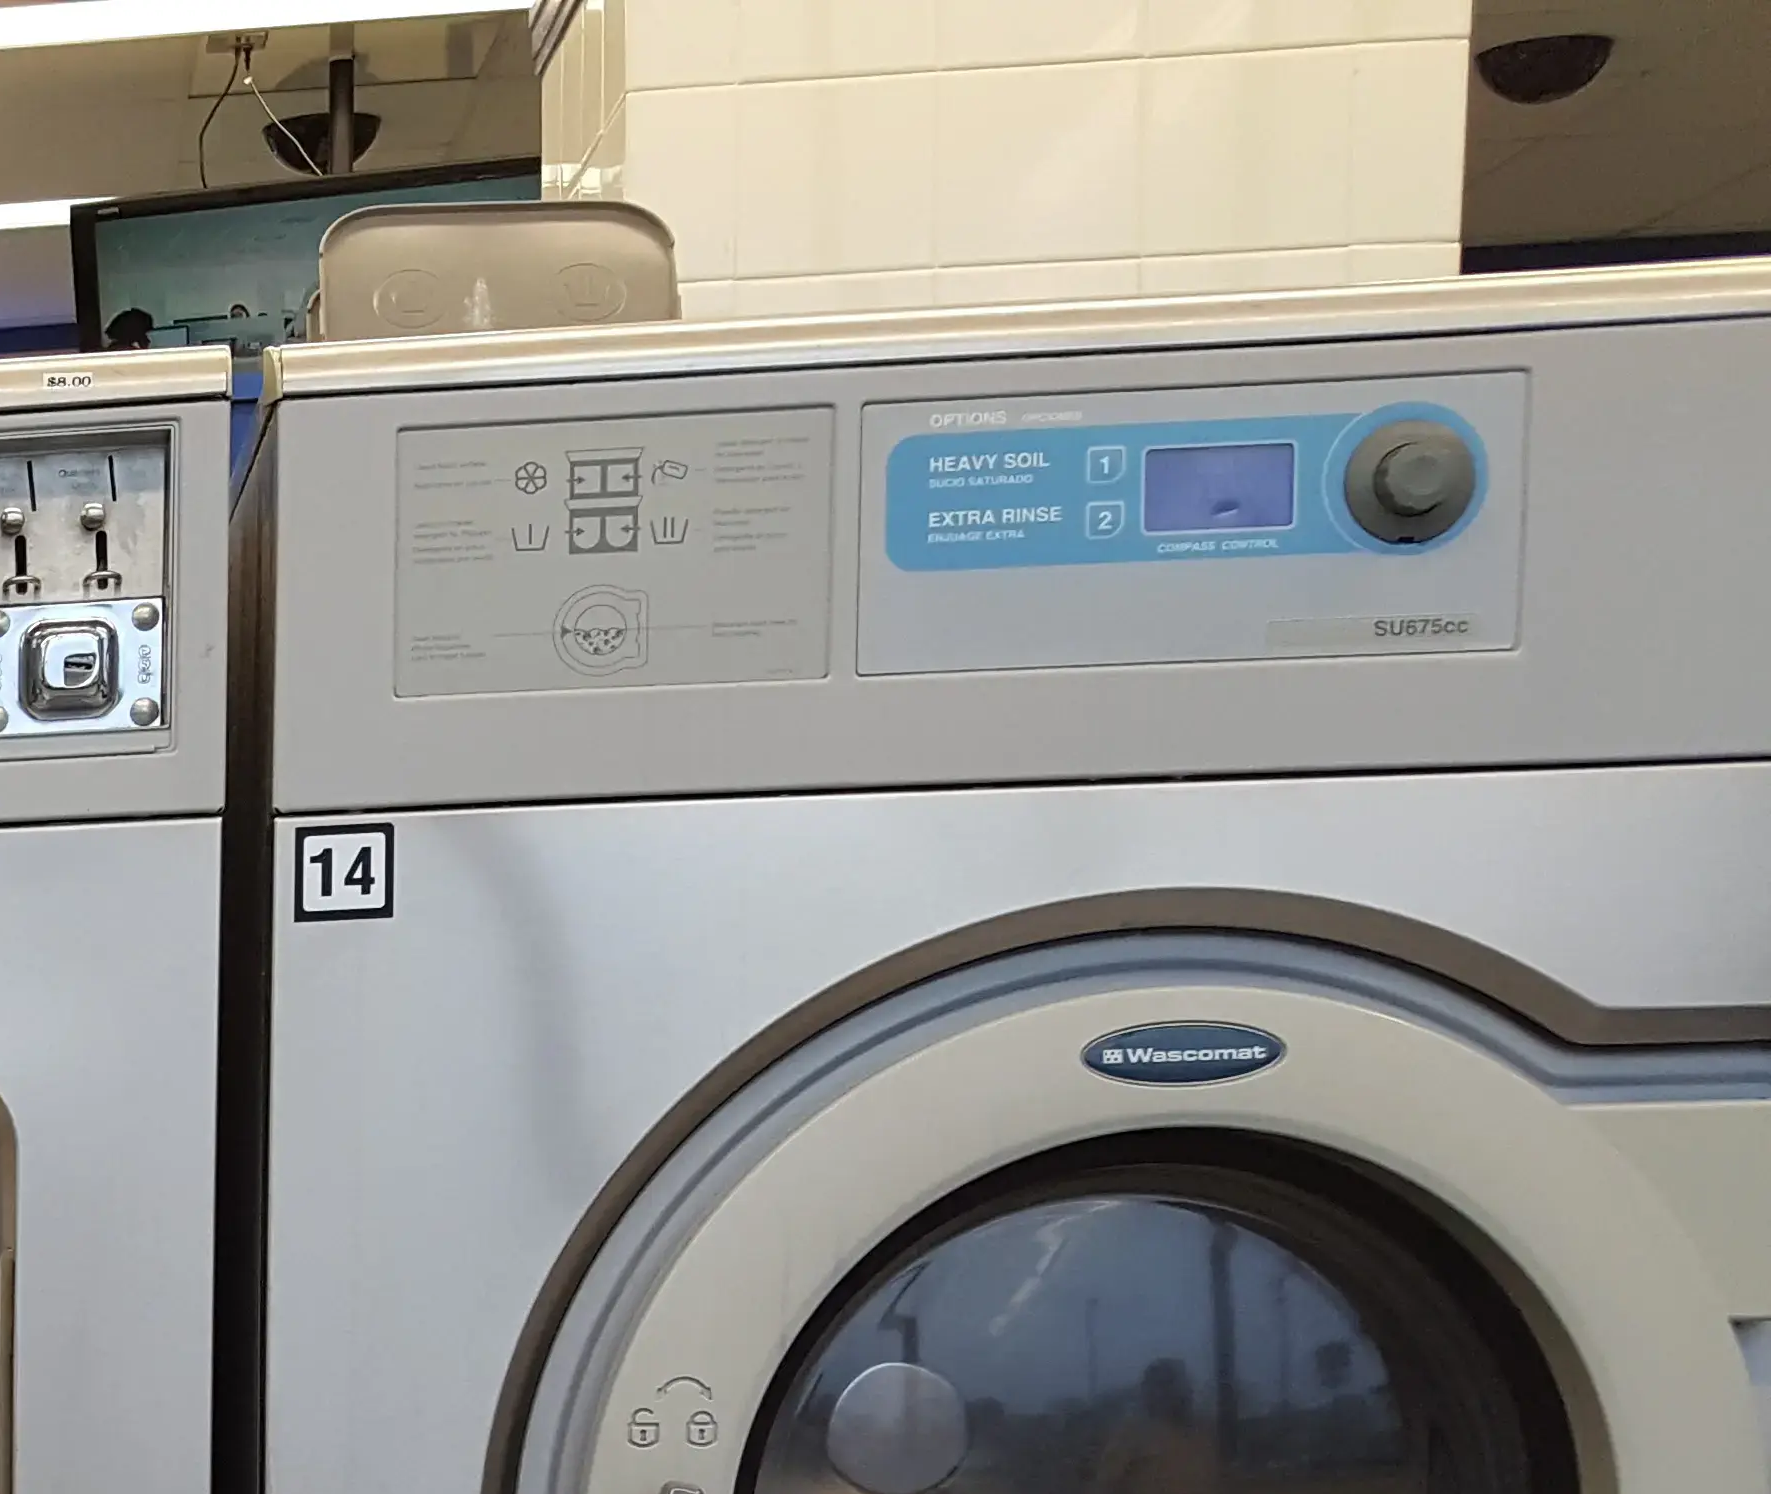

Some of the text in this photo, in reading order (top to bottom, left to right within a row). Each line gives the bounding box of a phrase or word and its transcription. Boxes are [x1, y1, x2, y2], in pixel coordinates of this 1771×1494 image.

[47, 376, 91, 388] $8.00
[929, 411, 1007, 427] OPTIONS
[929, 452, 1110, 475] HEAVY SOIL 1
[929, 474, 1033, 488] SUCIO SATURADO
[928, 506, 1112, 530] EXTRA RINSE 2
[985, 529, 1025, 540] EXTRA
[1157, 539, 1279, 553] COMPASS CONTROL
[1374, 618, 1468, 638] SU675cc
[308, 847, 376, 898] 14
[1125, 1044, 1267, 1066] Wascomat
